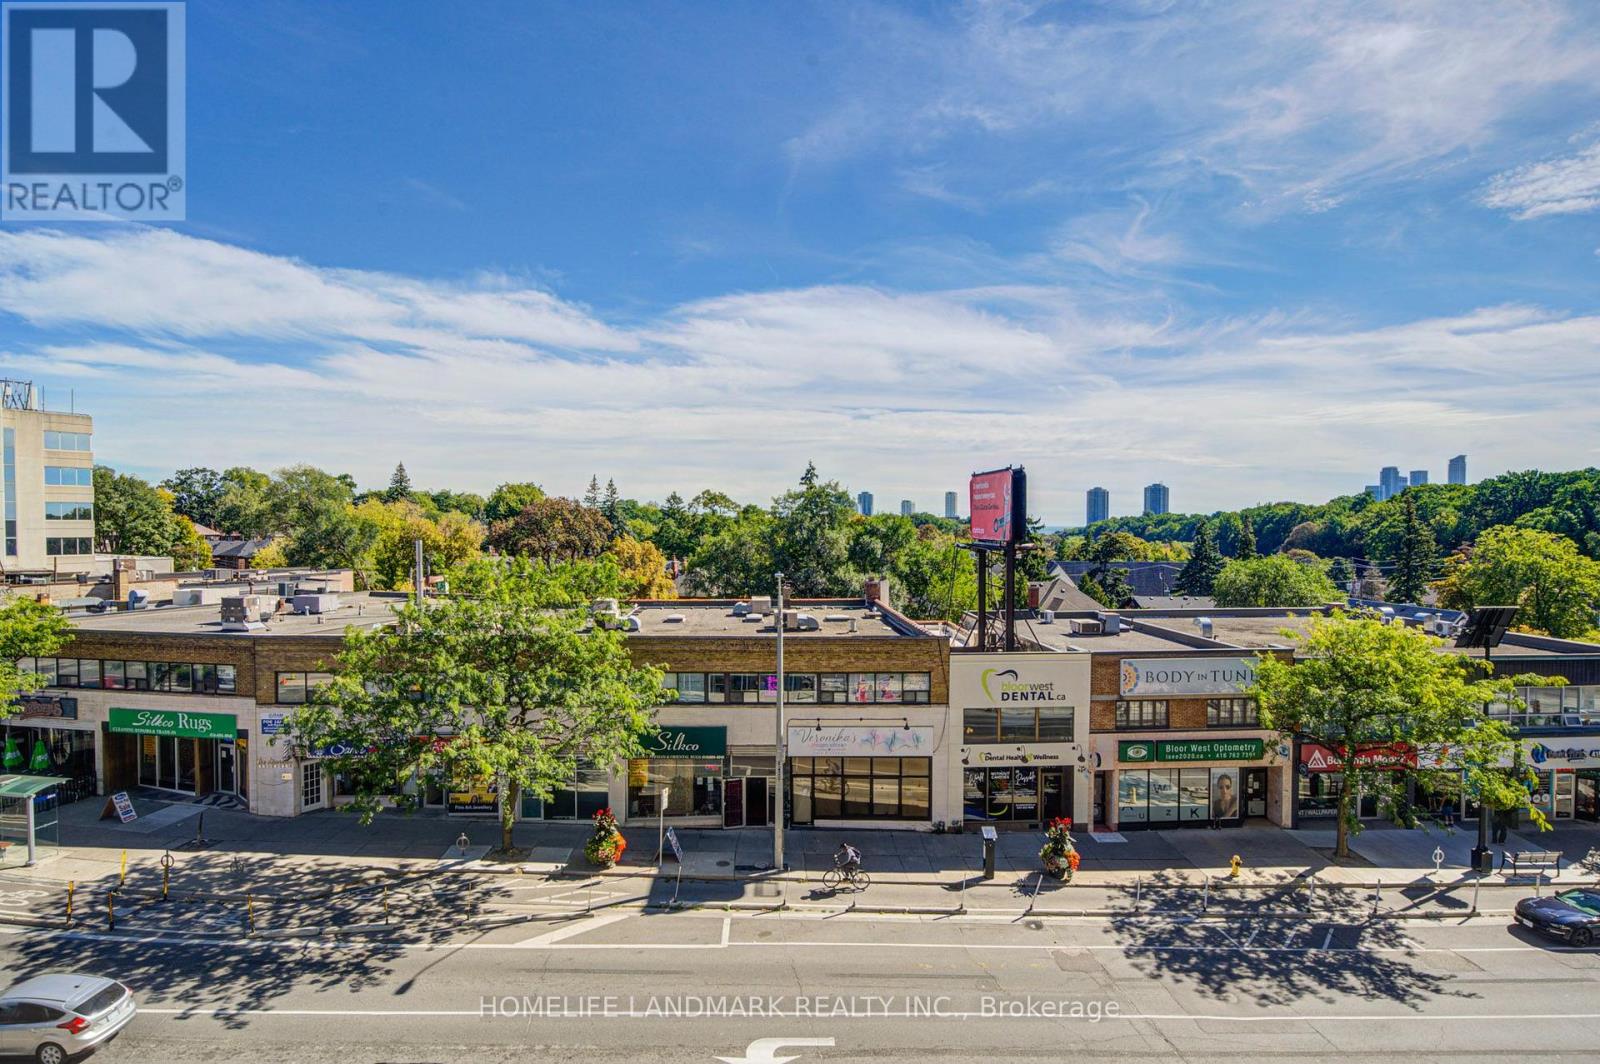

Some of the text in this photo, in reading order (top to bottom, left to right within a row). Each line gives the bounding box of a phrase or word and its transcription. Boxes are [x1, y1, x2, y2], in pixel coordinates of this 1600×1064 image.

[1145, 671, 1195, 683] BODY
[1001, 691, 1066, 701] DENTAL.ca
[132, 711, 212, 733] Silkco Rugs
[650, 731, 699, 751] Silkco
[1165, 743, 1256, 752] Bloor West Optometry
[1190, 808, 1200, 818] K
